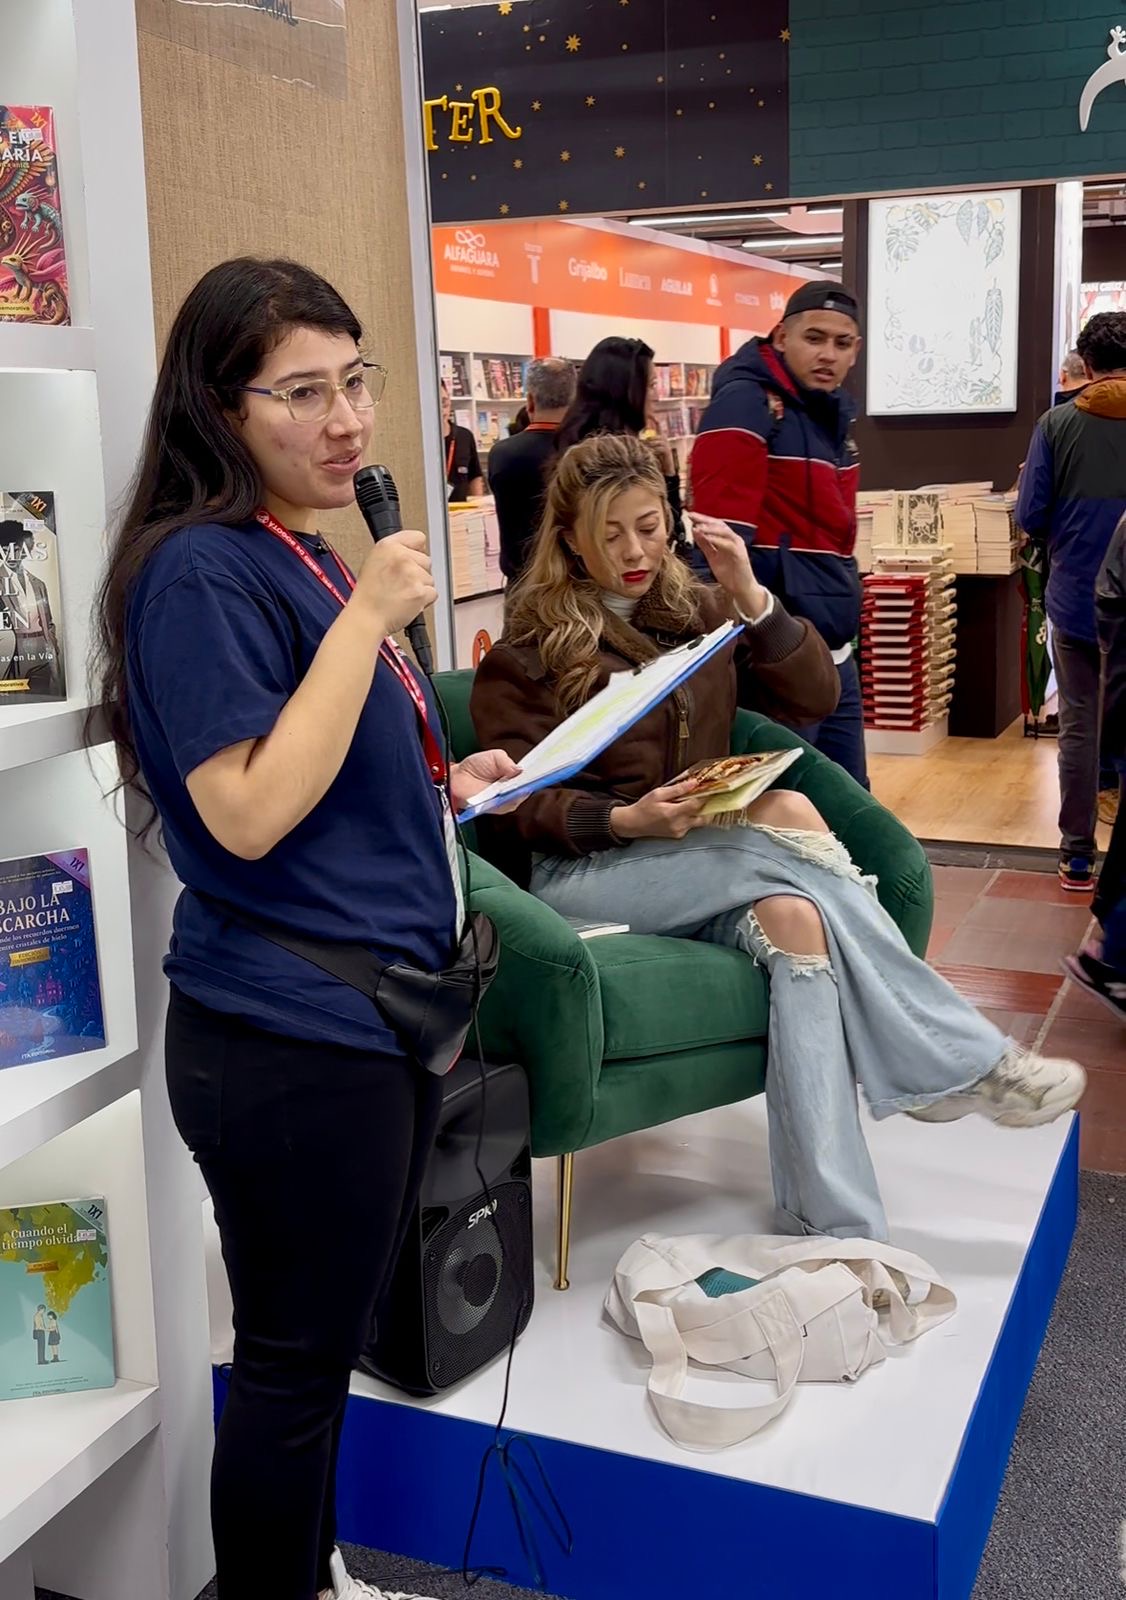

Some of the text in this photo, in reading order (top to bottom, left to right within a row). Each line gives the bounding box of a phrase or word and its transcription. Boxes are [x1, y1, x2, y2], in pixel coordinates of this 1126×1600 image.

[444, 244, 500, 268] ALFAGUARA
[568, 257, 608, 282] Grijalbo
[27, 653, 36, 661] la
[69, 857, 85, 872] 1X1
[41, 894, 60, 908] LA
[87, 1204, 103, 1220] 1X1
[11, 1223, 67, 1240] Cuando el
[2, 1239, 42, 1251] tiempo
